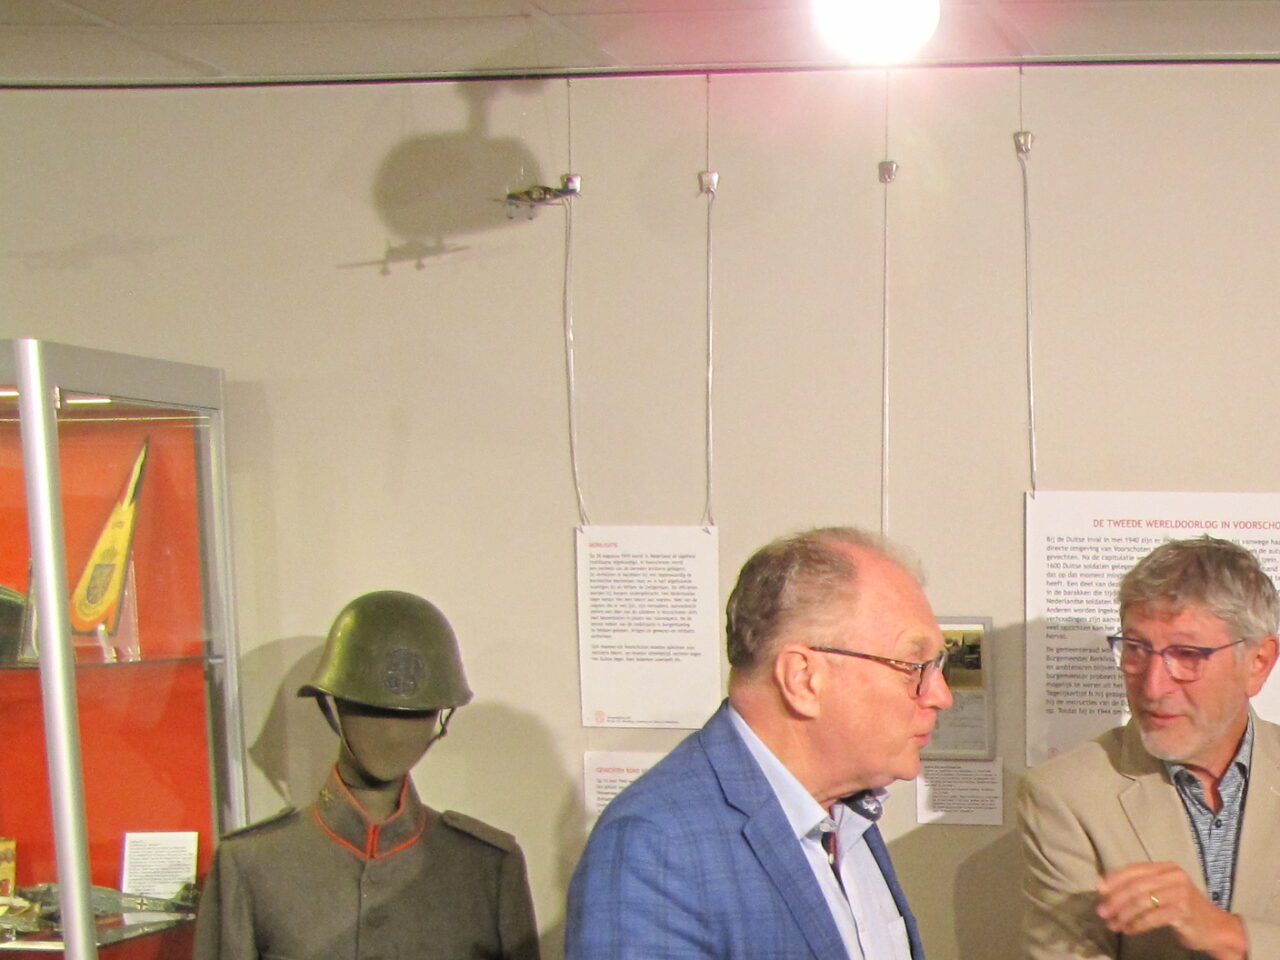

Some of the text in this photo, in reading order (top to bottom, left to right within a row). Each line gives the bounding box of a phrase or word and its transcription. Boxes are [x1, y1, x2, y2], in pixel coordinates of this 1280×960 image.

[1093, 519, 1104, 527] DE
[1107, 519, 1143, 528] TWEEDE
[1145, 519, 1218, 529] WERELDOORLOG
[1221, 521, 1230, 529] IN
